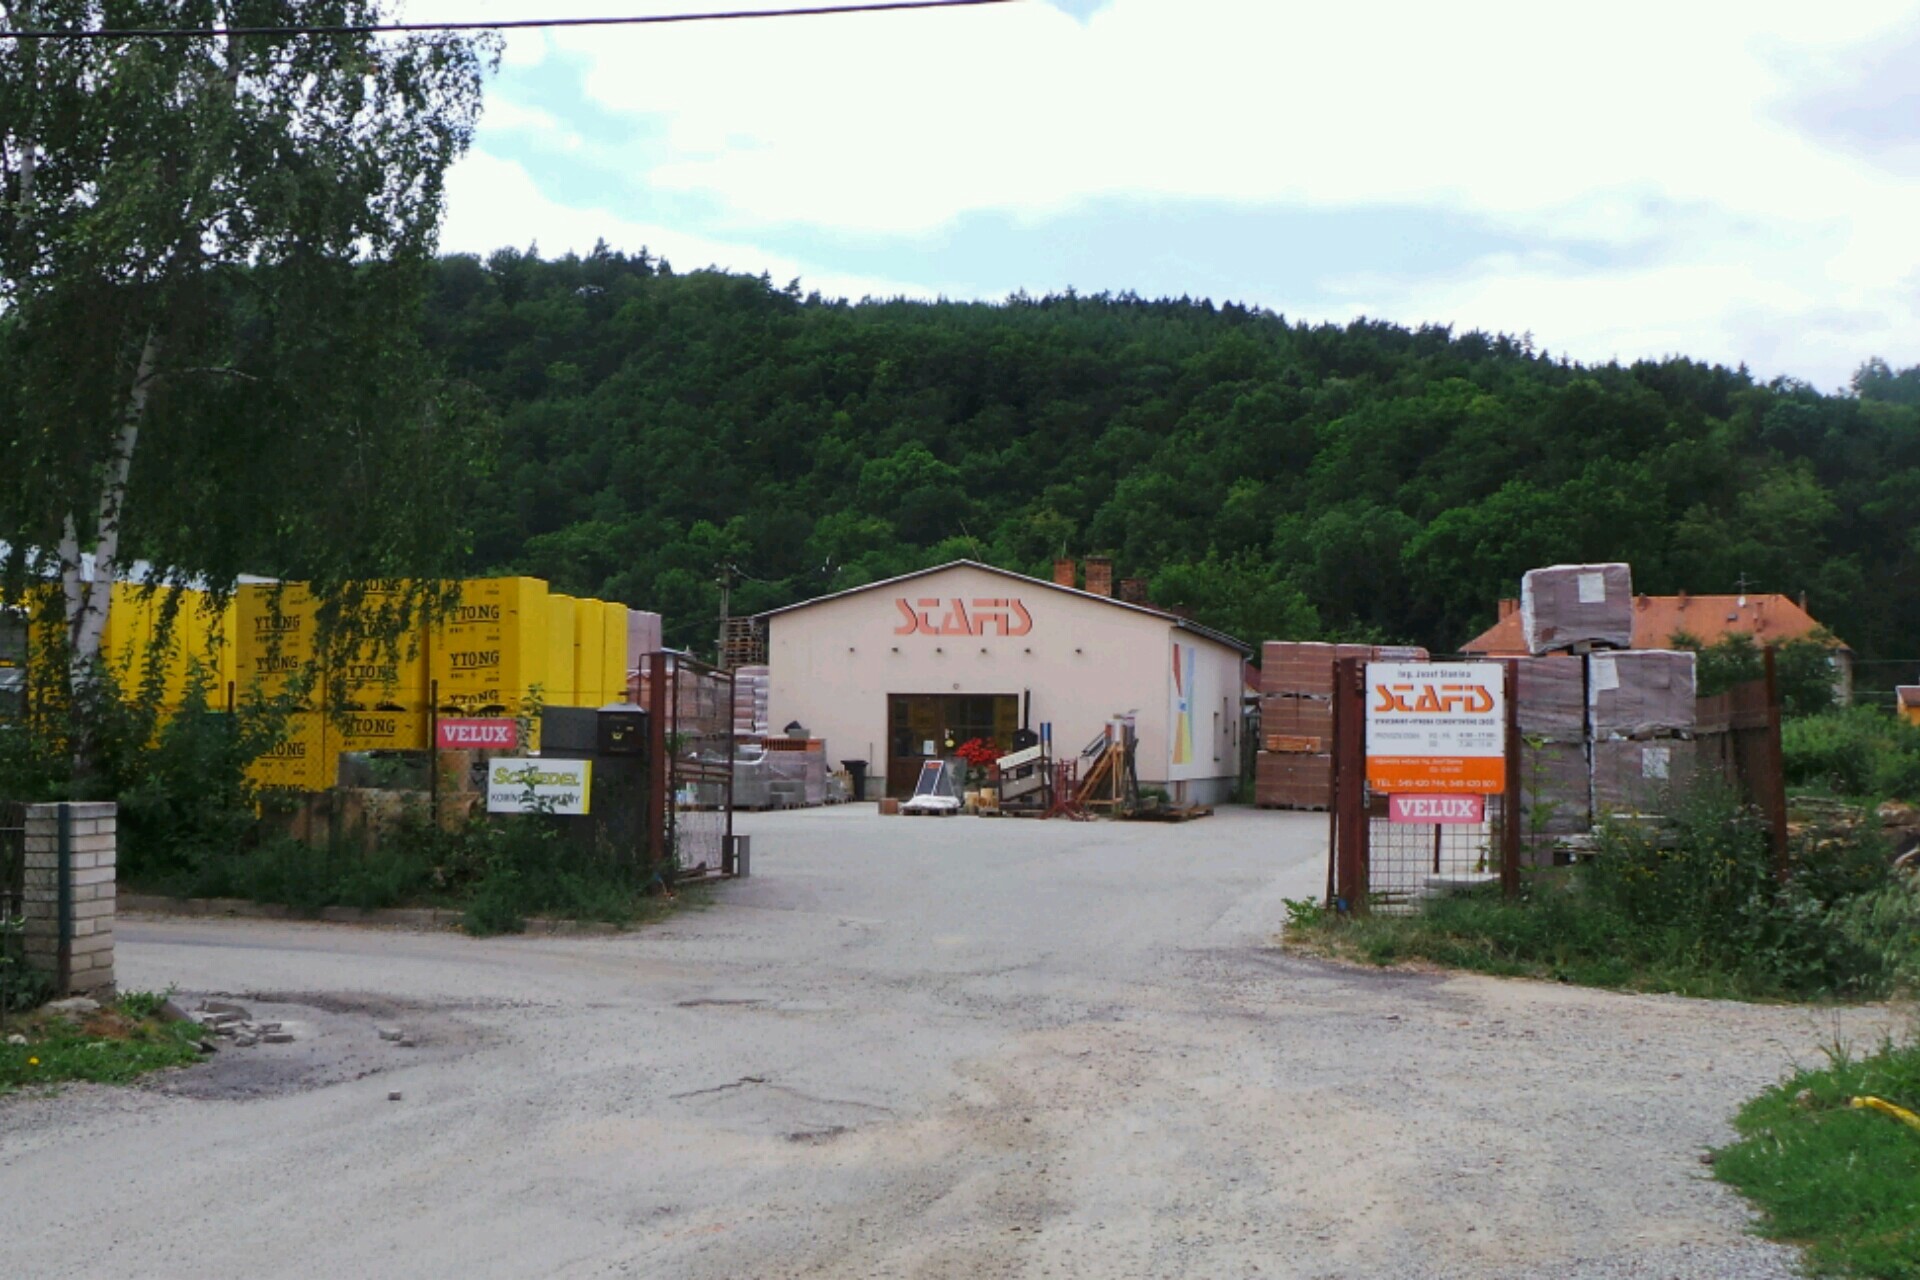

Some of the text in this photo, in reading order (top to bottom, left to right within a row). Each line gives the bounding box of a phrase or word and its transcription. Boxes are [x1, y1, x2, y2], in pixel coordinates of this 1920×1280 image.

[255, 615, 300, 629] YTNG
[894, 598, 1033, 636] STAFIS
[450, 651, 500, 666] YTONG
[348, 665, 398, 677] YTO
[1374, 684, 1495, 713] STAFIS
[443, 724, 508, 742] VELUX
[1397, 799, 1473, 817] VELUX
